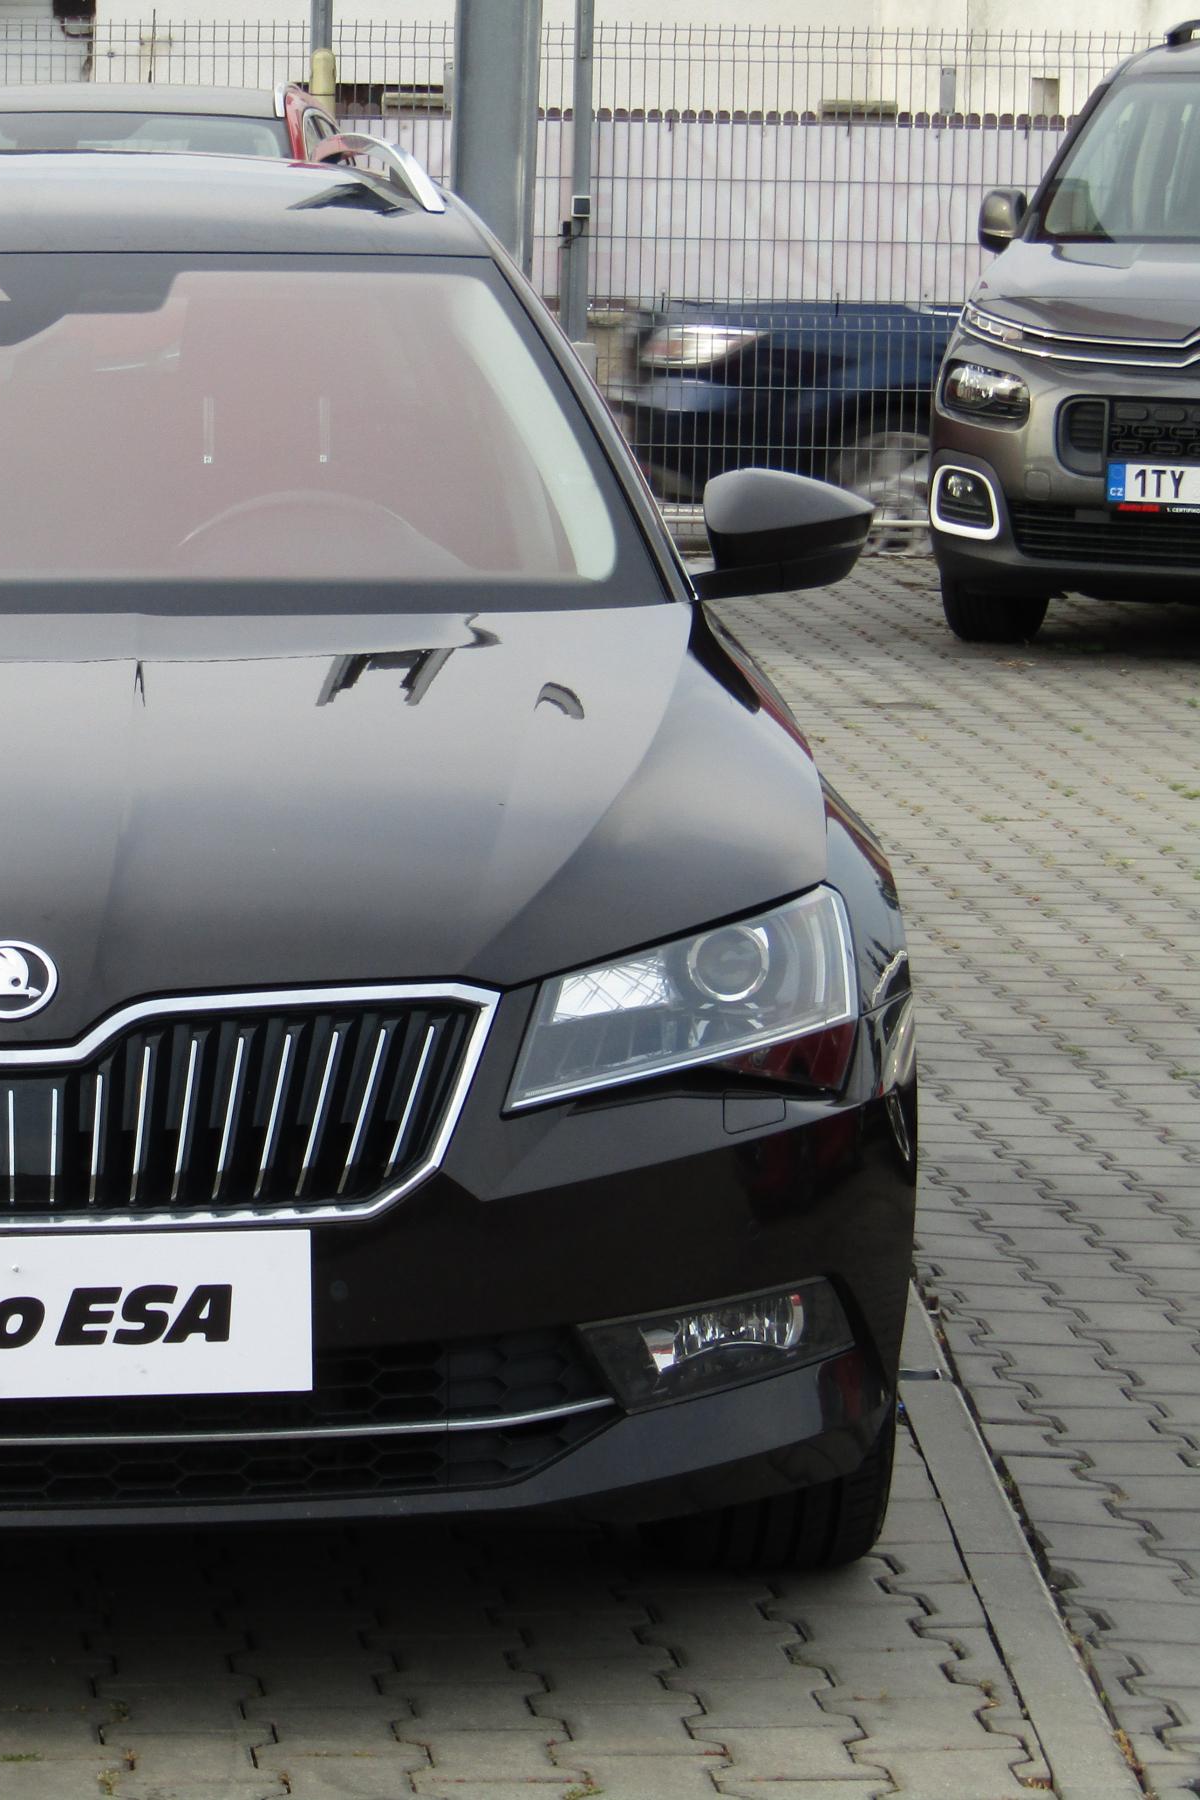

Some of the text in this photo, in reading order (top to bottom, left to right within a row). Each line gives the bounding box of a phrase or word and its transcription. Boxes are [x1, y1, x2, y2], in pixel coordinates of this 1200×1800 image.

[1109, 487, 1124, 496] CZ
[1134, 469, 1185, 499] 1TY
[55, 1284, 232, 1346] ESA
